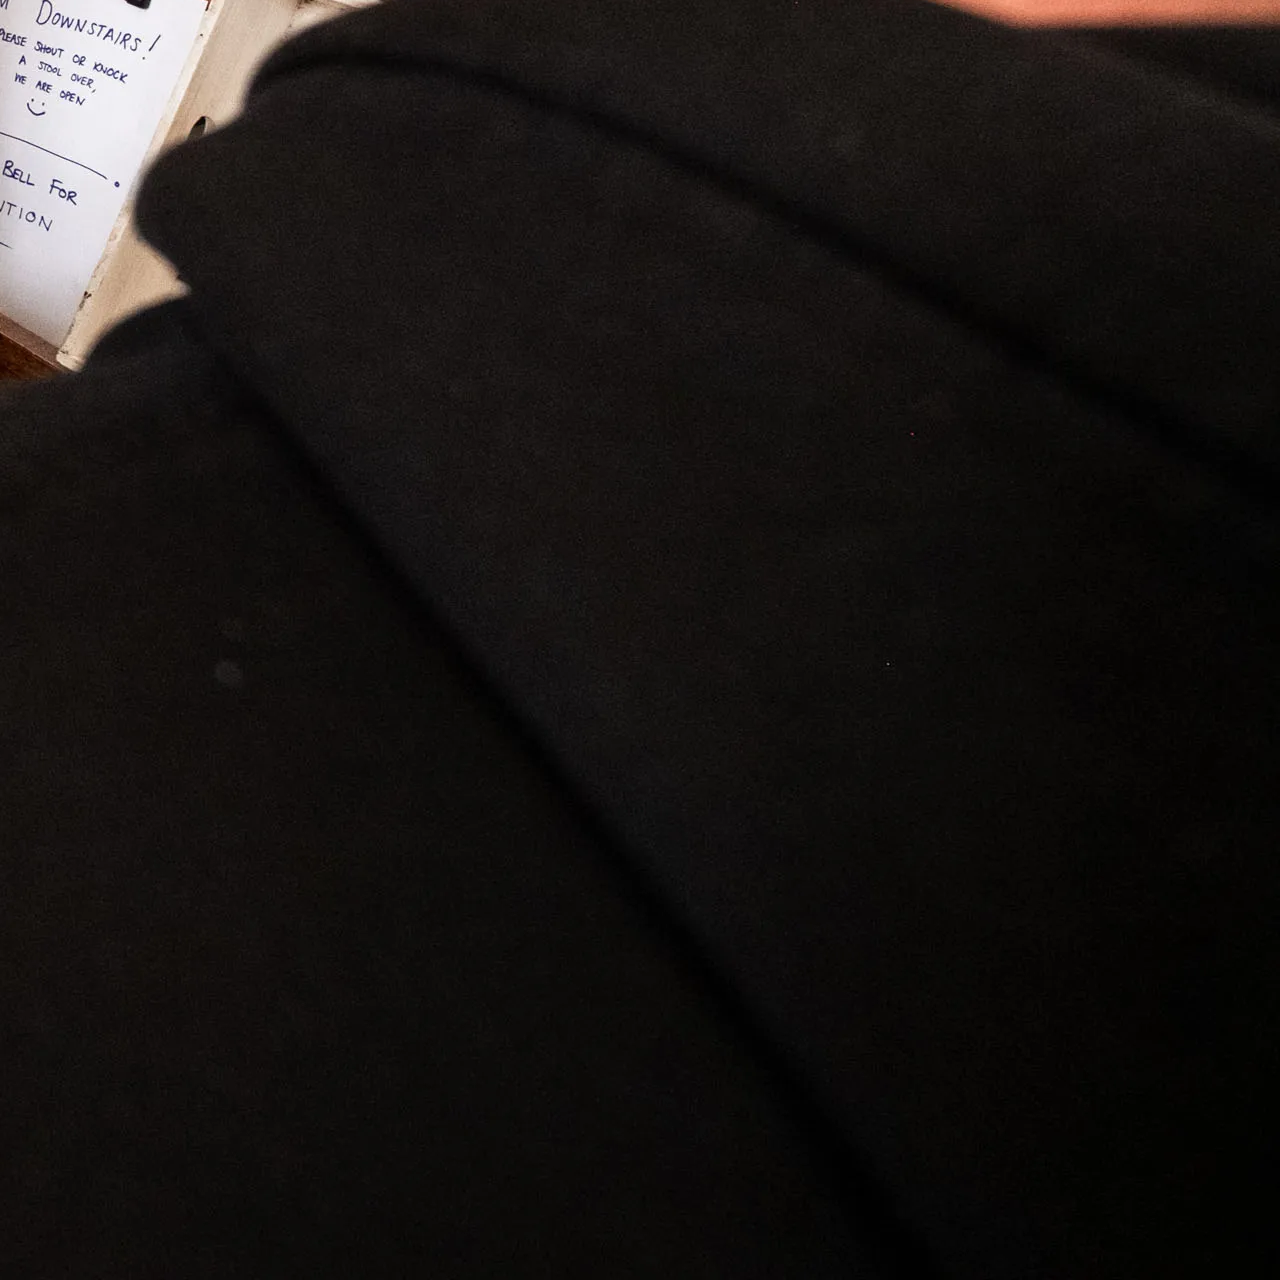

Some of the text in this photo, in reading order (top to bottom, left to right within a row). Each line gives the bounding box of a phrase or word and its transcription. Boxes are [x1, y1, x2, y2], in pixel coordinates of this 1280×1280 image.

[18, 55, 26, 65] A
[38, 61, 62, 77] STOOL
[34, 41, 64, 57] SHOUT
[72, 54, 87, 66] OR
[93, 62, 129, 84] KNOCK
[14, 73, 86, 106] WE ARE OPEN
[2, 160, 35, 186] BELL
[49, 179, 78, 206] FOR
